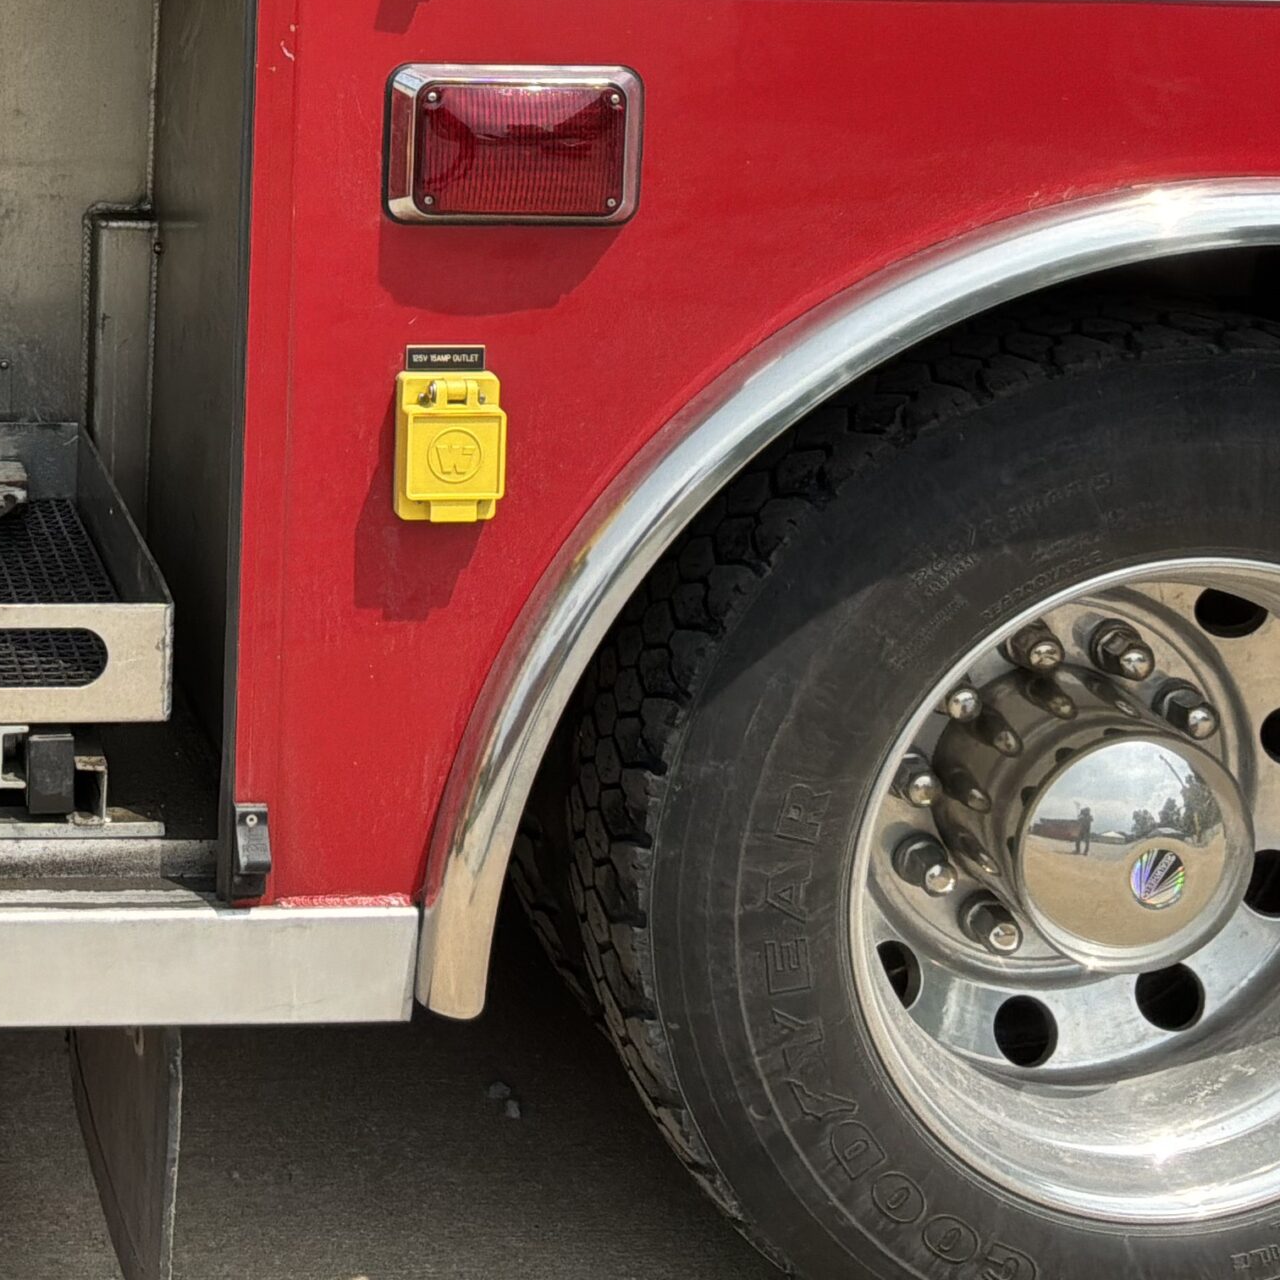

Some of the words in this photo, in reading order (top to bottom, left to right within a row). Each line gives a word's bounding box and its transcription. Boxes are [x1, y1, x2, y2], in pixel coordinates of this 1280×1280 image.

[430, 354, 451, 362] 15AMP
[452, 353, 479, 362] OUTLET
[763, 783, 1039, 1280] GOODYEAR
